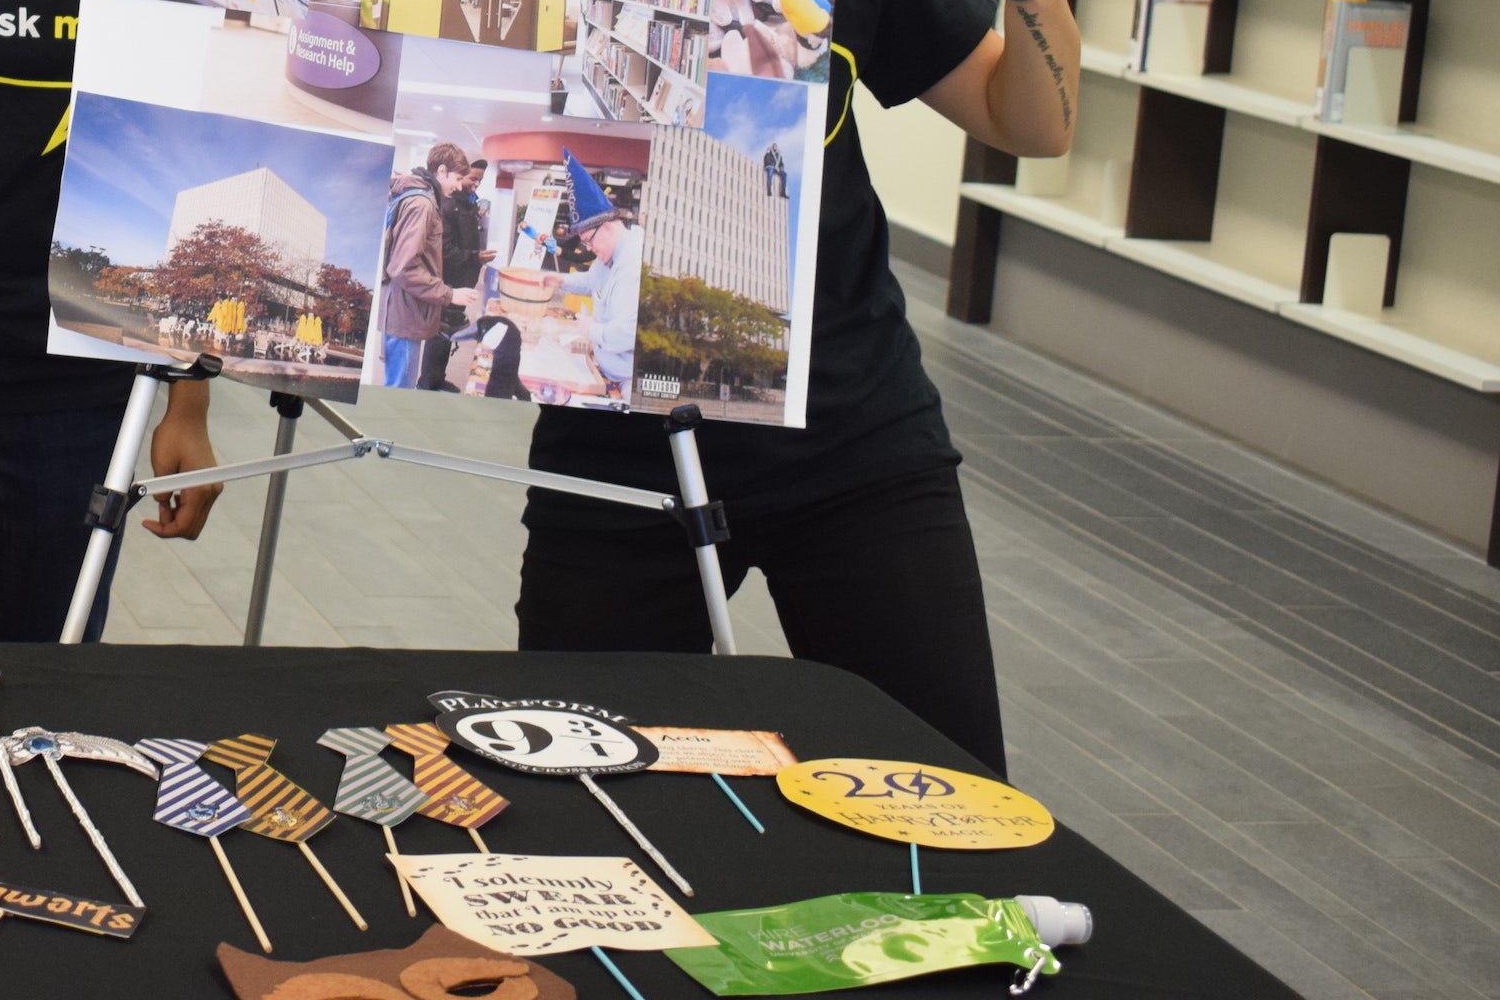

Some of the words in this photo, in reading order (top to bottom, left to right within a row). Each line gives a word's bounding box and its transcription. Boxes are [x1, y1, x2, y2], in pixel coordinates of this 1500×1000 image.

[298, 29, 344, 53] Assignment
[345, 40, 357, 56] &
[295, 43, 327, 66] Research
[328, 53, 355, 76] Help
[644, 380, 679, 394] ADVISORY
[470, 719, 553, 755] 9
[875, 803, 937, 811] YEARS
[940, 803, 967, 811] OF
[837, 811, 933, 828] HARRY
[928, 811, 1051, 827] POTTER
[930, 828, 994, 838] MAGIC
[472, 871, 614, 893] solemnly
[463, 889, 637, 908] SWEAR
[474, 908, 522, 922] that
[548, 904, 582, 914] am
[588, 907, 619, 921] up
[623, 907, 646, 918] to
[483, 921, 544, 937] NO
[553, 917, 663, 933] GOOD
[758, 914, 902, 951] WATERLOO
